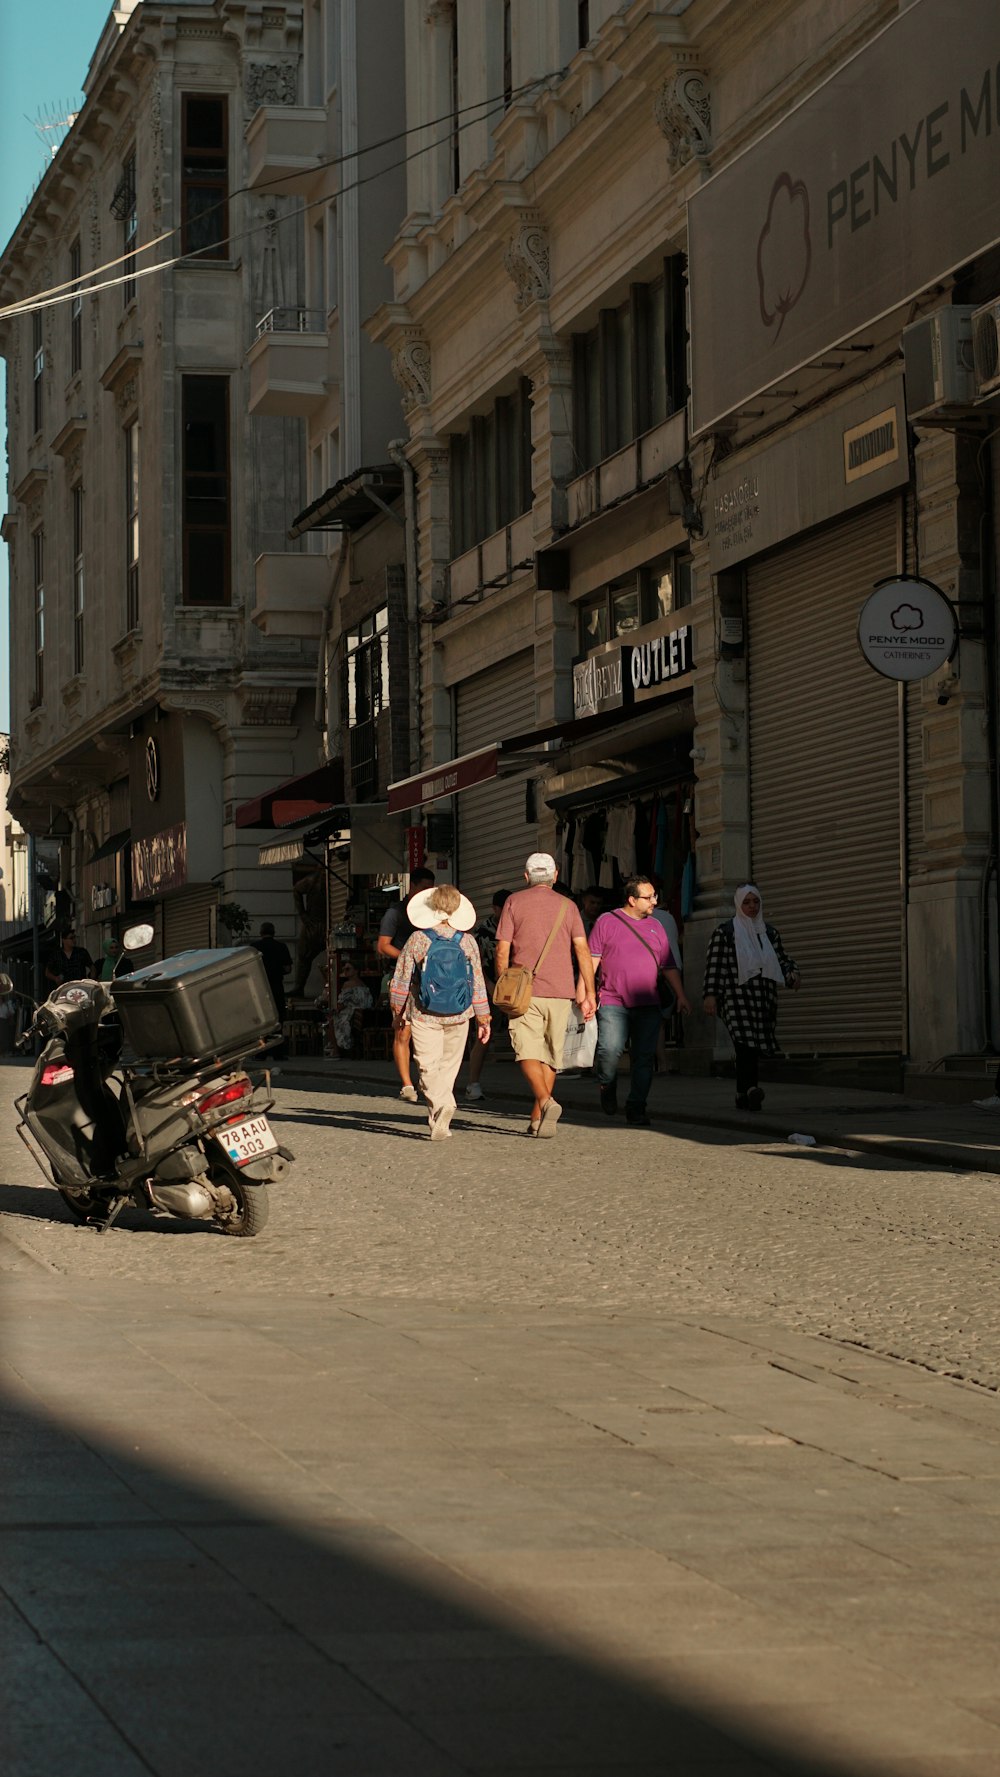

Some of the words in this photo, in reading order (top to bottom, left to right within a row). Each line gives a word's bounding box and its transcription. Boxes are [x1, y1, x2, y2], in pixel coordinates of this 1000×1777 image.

[827, 101, 950, 249] PENYE
[961, 62, 1000, 153] M
[869, 636, 907, 644] PENYE
[910, 637, 945, 645] MOOD
[631, 625, 688, 689] OUTLET
[222, 1131, 240, 1146] 78
[242, 1119, 267, 1139] AAU
[240, 1138, 264, 1156] 303
